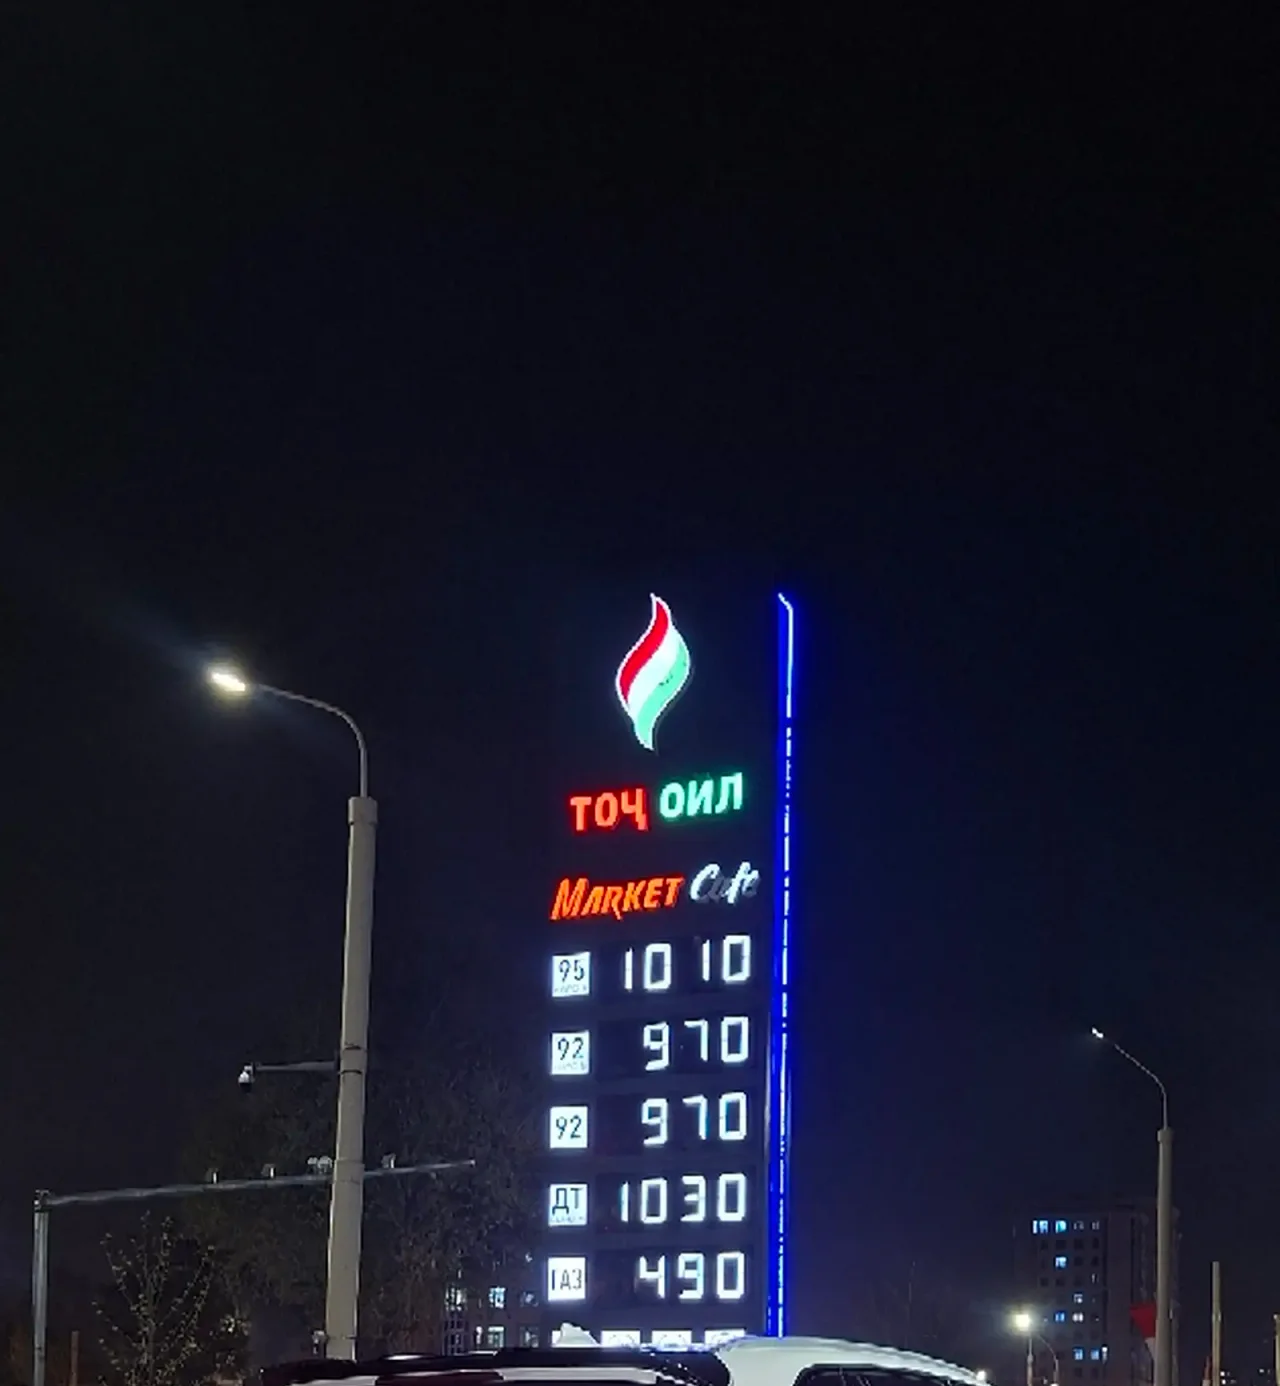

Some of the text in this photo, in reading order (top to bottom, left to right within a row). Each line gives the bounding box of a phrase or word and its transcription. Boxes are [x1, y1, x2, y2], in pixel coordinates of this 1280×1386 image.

[659, 771, 744, 819] ОИЛ
[558, 959, 586, 983] 95
[557, 1016, 750, 1071] 92 970
[555, 1091, 748, 1147] 92 970
[551, 1172, 747, 1225] ДТ 1030
[638, 1251, 746, 1300] 490
